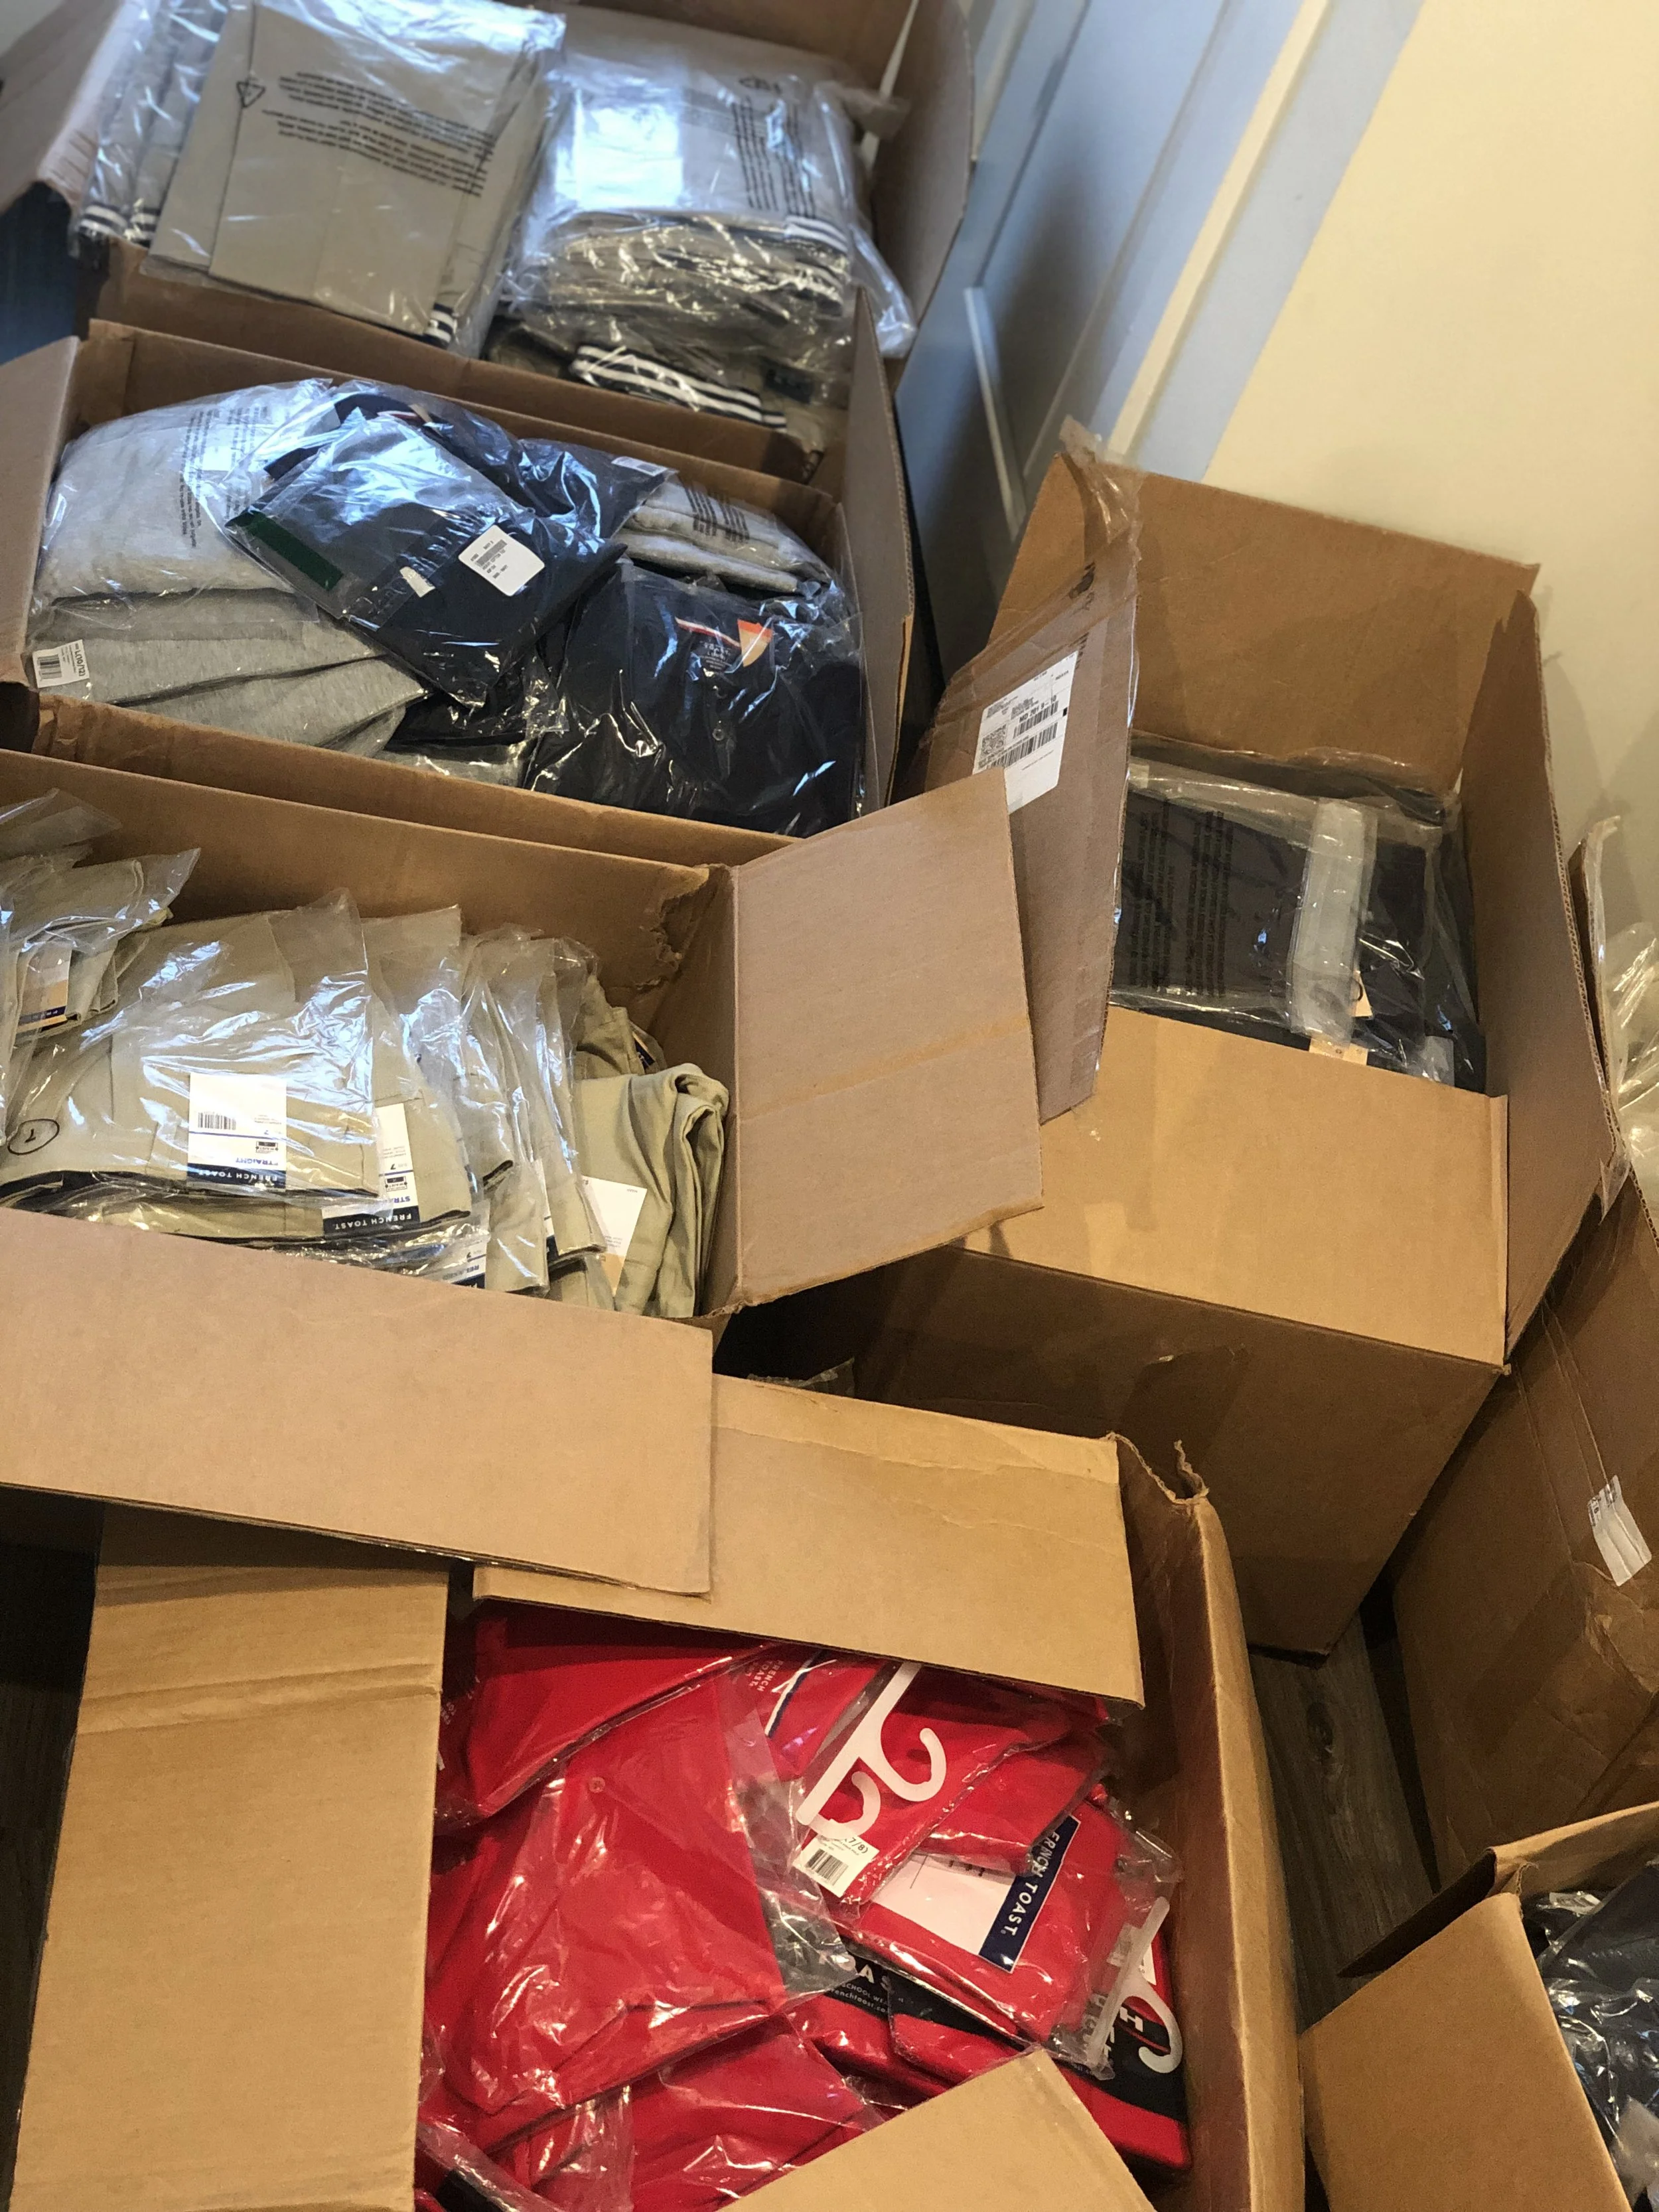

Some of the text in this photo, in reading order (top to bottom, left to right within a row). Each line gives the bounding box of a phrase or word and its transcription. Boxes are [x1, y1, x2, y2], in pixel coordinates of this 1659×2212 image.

[236, 1173, 277, 1182] FRENCH
[371, 1213, 412, 1224] FRENCH
[757, 1660, 784, 1692] FRENCH
